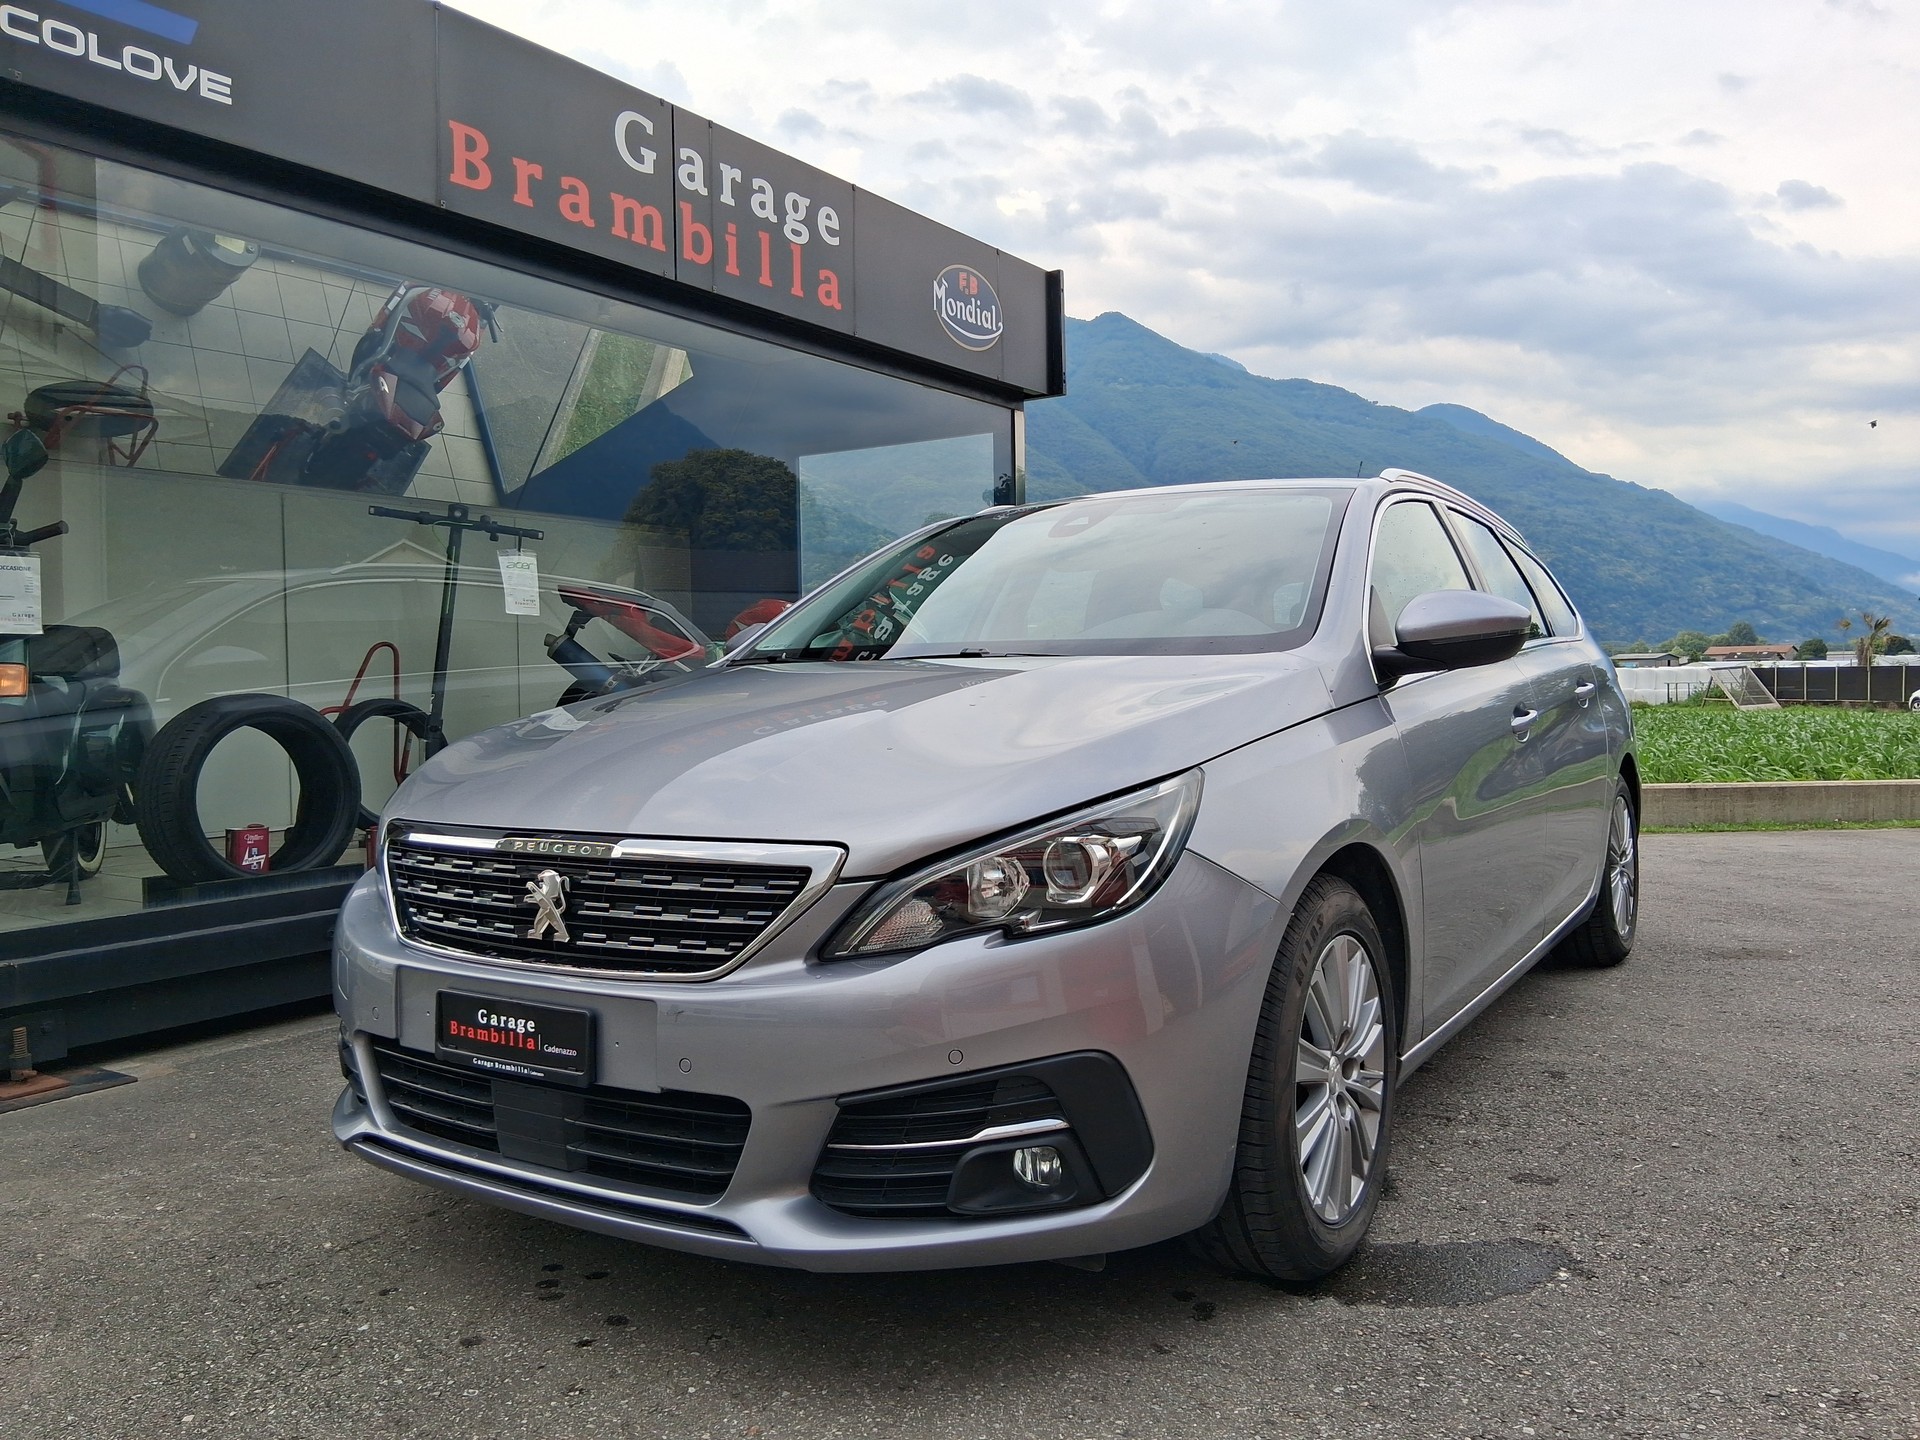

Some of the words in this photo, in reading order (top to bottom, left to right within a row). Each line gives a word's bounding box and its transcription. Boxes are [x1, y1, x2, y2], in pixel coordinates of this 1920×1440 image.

[0, 4, 233, 105] COLOVE
[614, 110, 840, 246] Garage
[449, 119, 842, 310] Brambilla
[933, 277, 998, 331] Mondial
[506, 561, 534, 570] acer
[513, 841, 606, 856] PEUGEOT
[450, 1020, 536, 1050] Brambilla
[543, 1043, 578, 1057] Cadenazzo
[477, 1008, 536, 1032] Garage
